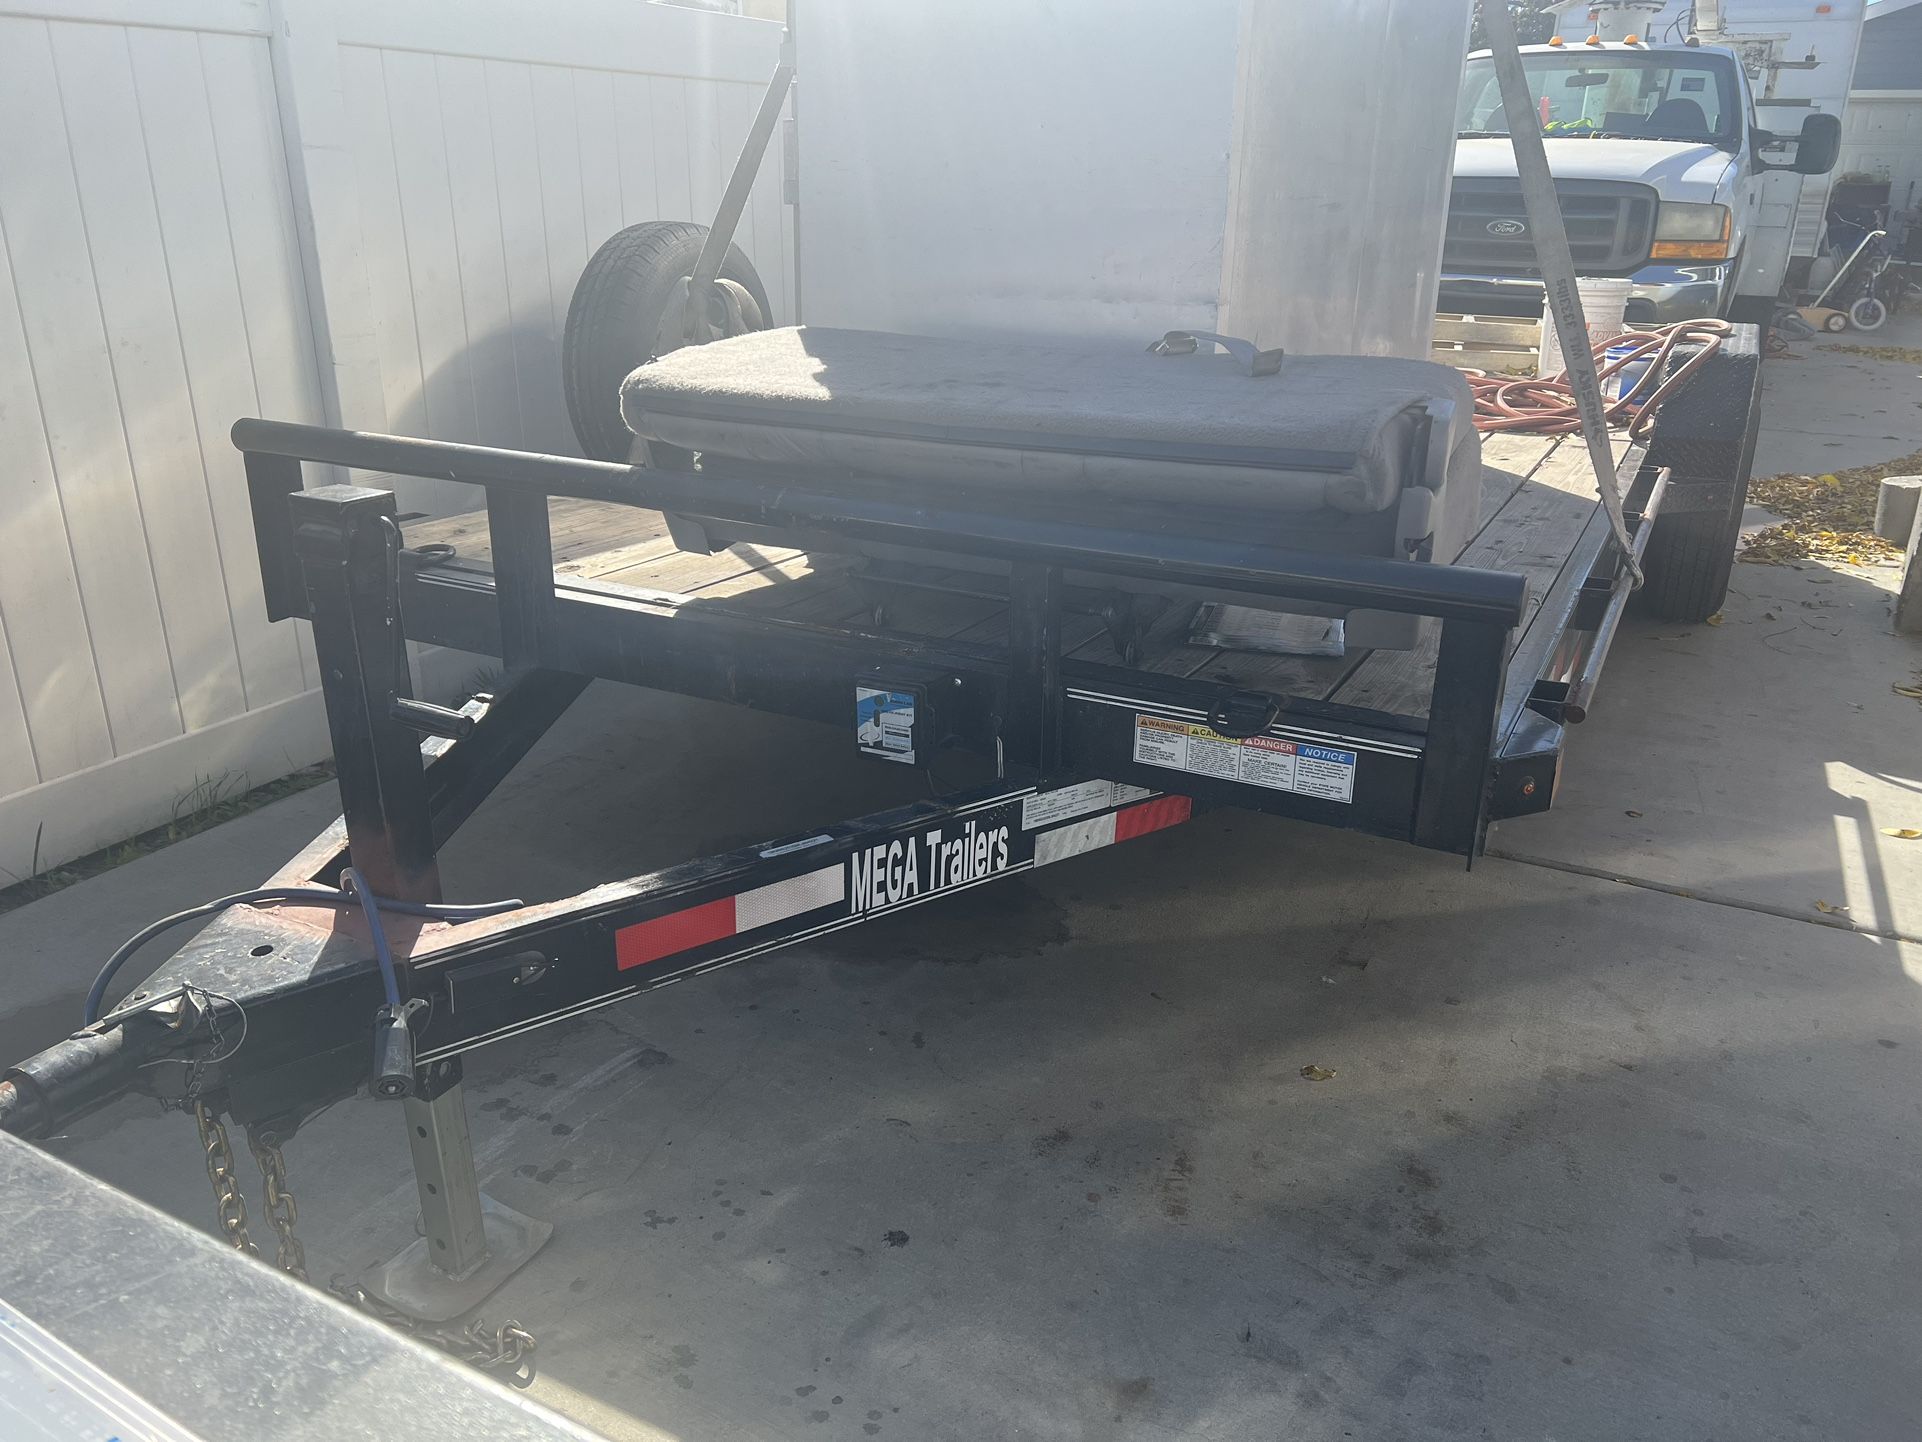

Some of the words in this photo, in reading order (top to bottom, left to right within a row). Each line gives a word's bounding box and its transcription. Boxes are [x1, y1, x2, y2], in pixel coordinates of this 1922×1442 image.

[1494, 222, 1517, 233] Ford
[1576, 367, 1601, 426] HUSKY
[1148, 719, 1185, 732] WARNING
[1253, 738, 1293, 752] DANGER
[1304, 748, 1346, 762] NOTICE
[851, 836, 919, 914] MEGA
[926, 820, 1009, 891] Trailers
